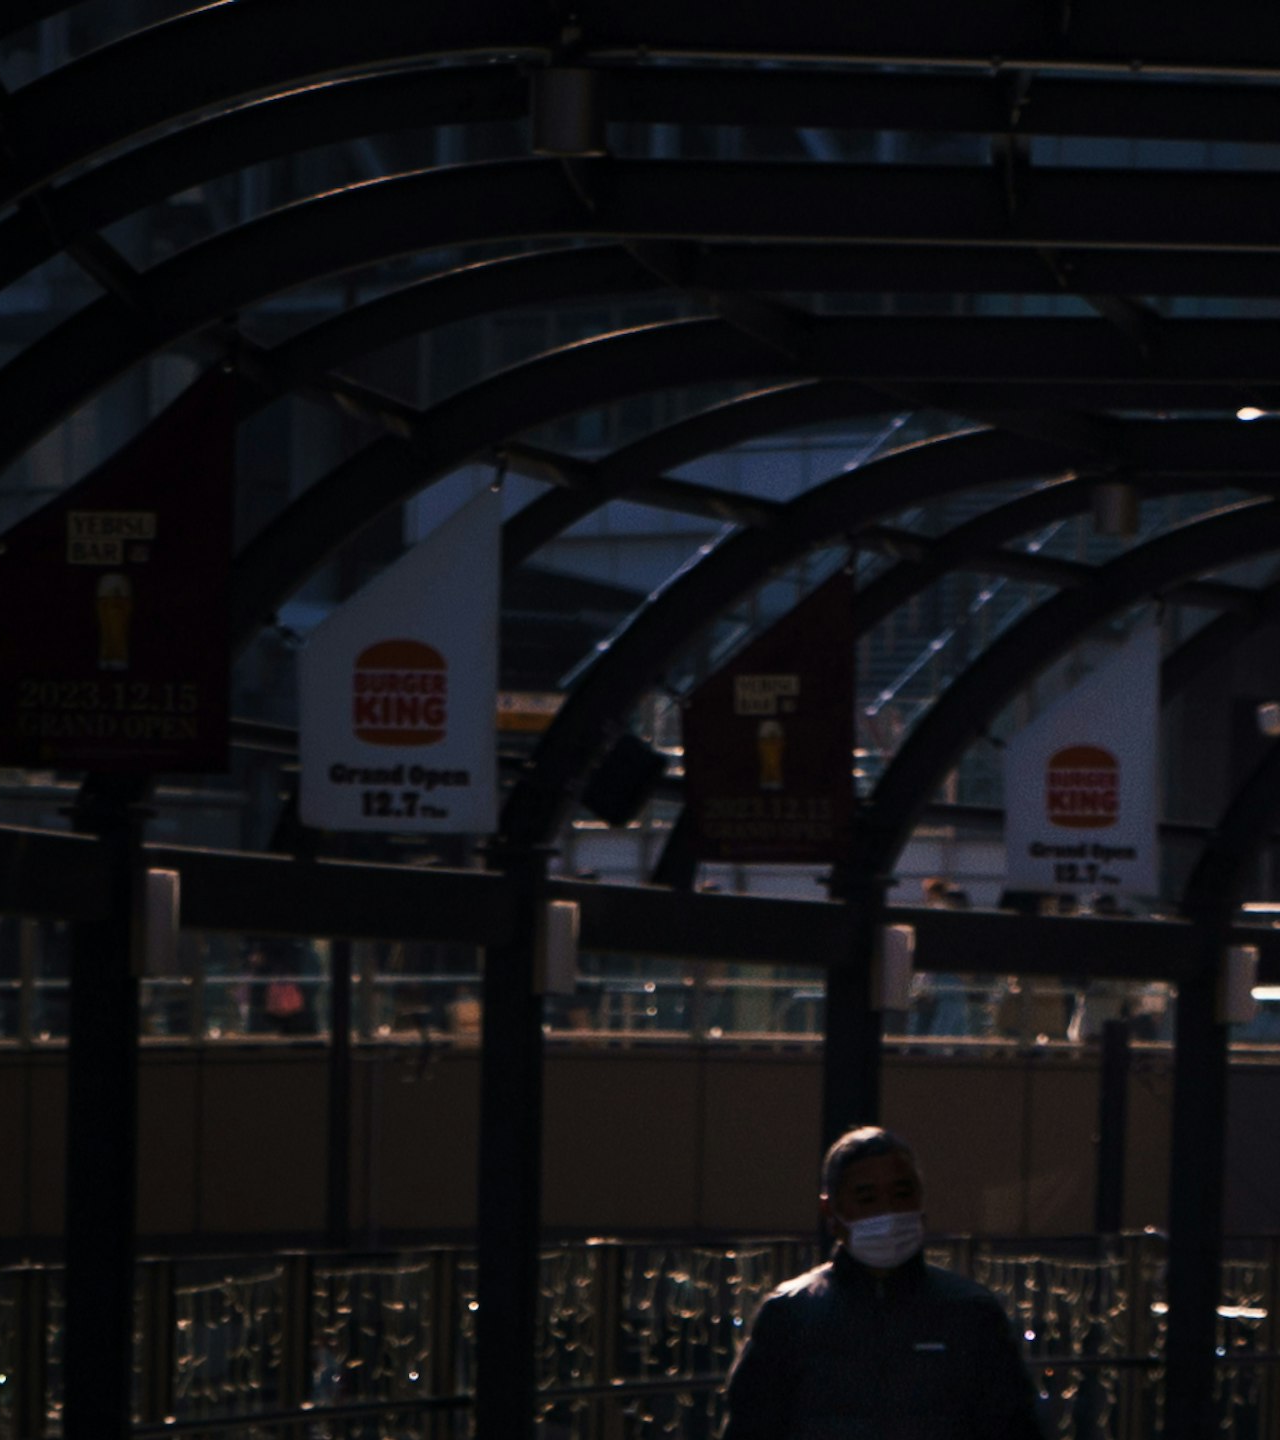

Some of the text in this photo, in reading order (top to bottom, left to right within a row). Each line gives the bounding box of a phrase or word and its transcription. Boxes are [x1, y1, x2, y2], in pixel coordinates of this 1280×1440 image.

[71, 539, 118, 562] BAR
[18, 680, 200, 710] 2023.12.15
[354, 672, 446, 694] BURGER
[354, 697, 446, 726] KING
[17, 712, 199, 740] GRAND OPEN
[330, 763, 470, 791] Grand Open
[362, 791, 419, 817] 12.7
[1049, 789, 1118, 811] KING
